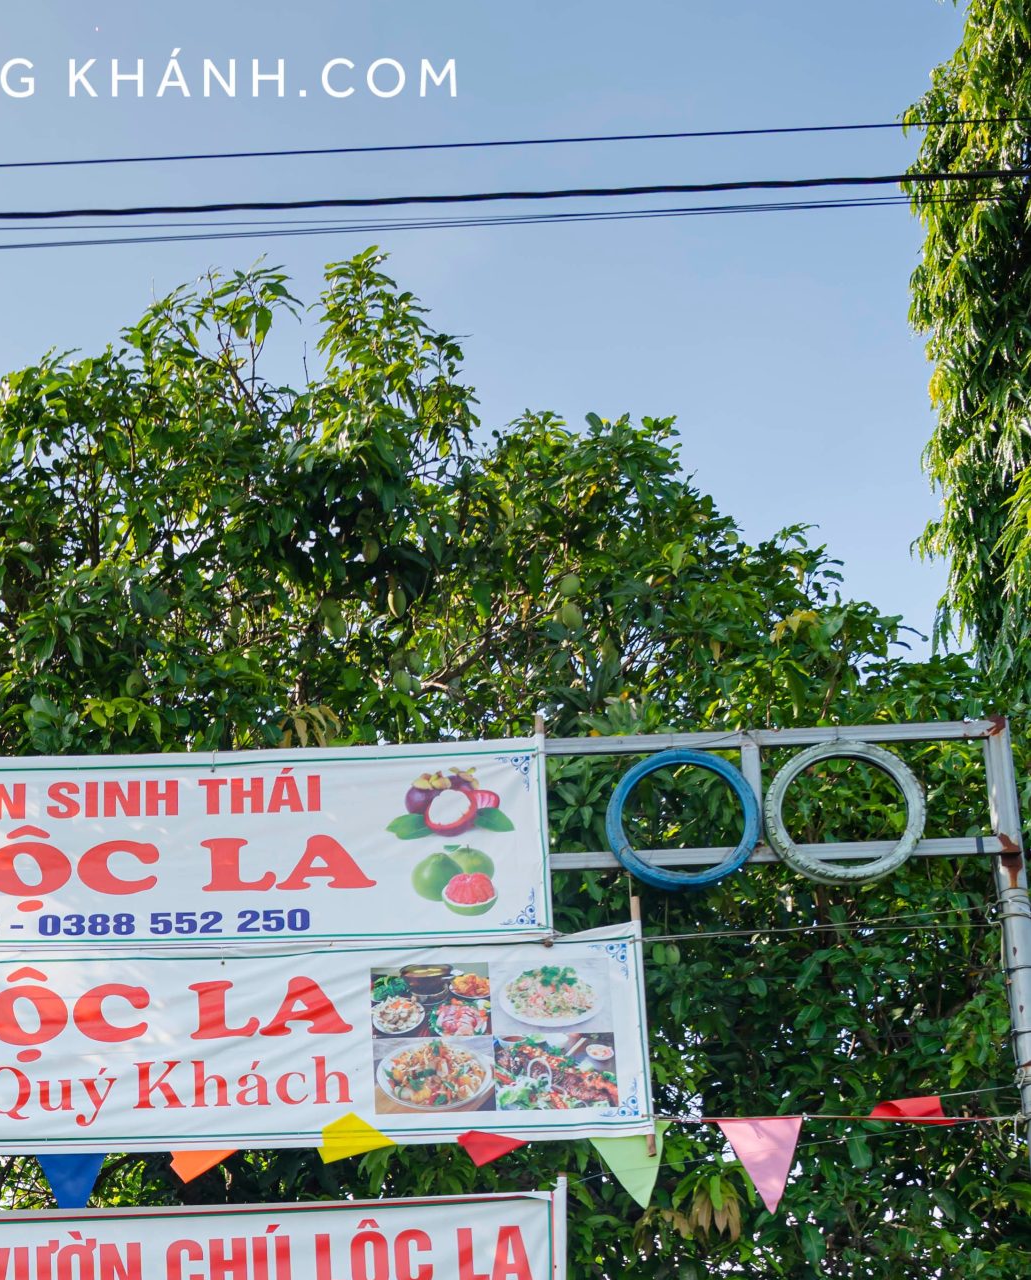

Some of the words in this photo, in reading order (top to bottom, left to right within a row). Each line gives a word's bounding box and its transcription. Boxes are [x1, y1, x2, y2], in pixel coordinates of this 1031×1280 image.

[47, 780, 179, 819] SINH
[198, 767, 321, 815] THÁI
[201, 834, 377, 892] LA
[39, 913, 135, 936] 0388
[150, 911, 222, 934] 552
[237, 909, 310, 932] 250
[189, 976, 353, 1040] LA
[134, 1056, 351, 1109] Khách
